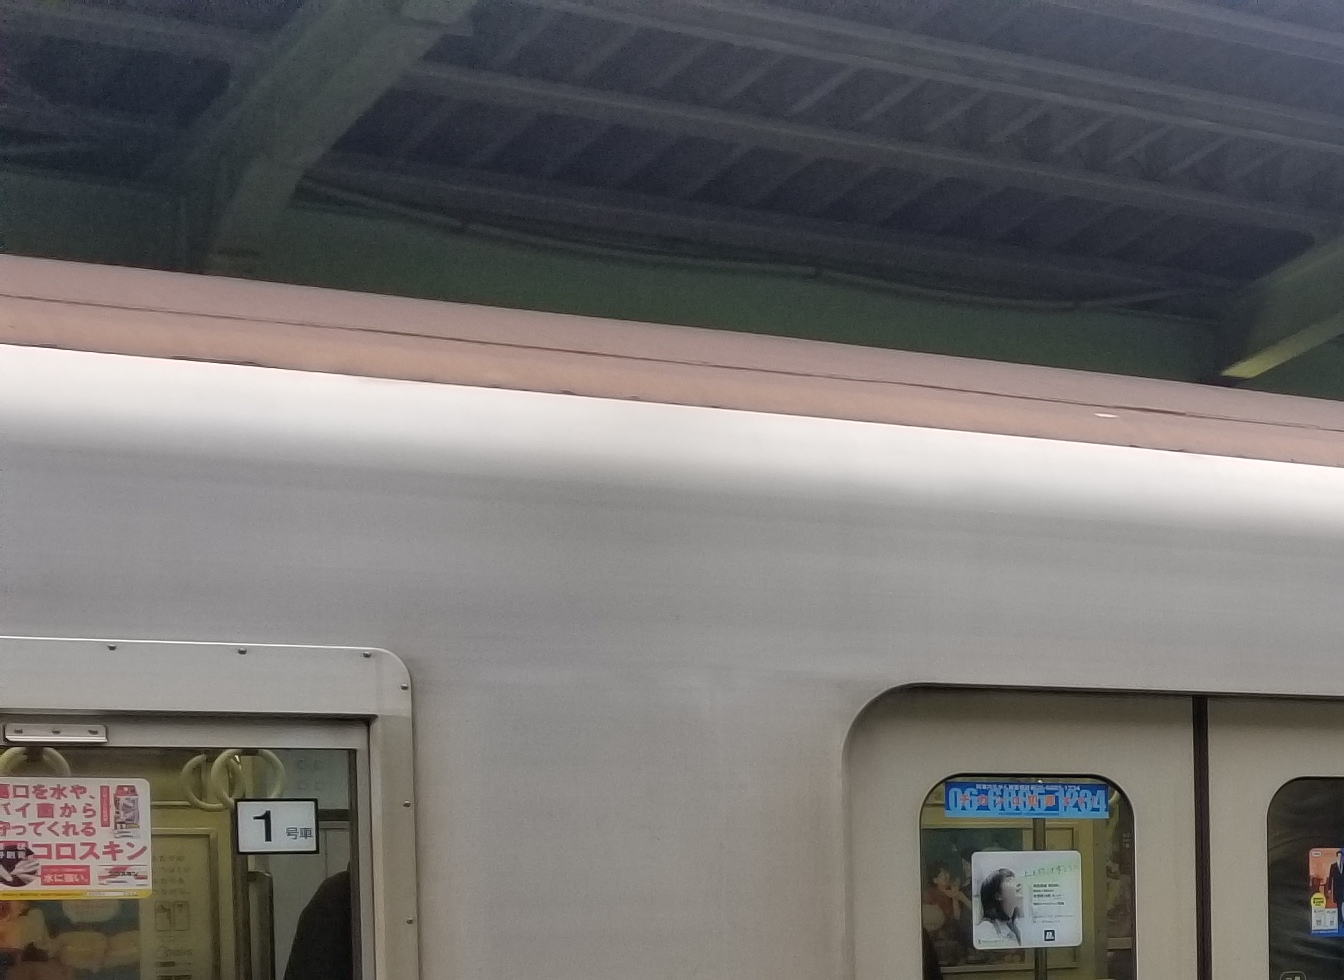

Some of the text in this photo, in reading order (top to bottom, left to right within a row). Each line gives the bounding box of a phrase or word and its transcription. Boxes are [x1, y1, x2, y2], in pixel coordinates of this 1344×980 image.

[253, 810, 272, 842] 1
[31, 841, 148, 861] コロスキン
